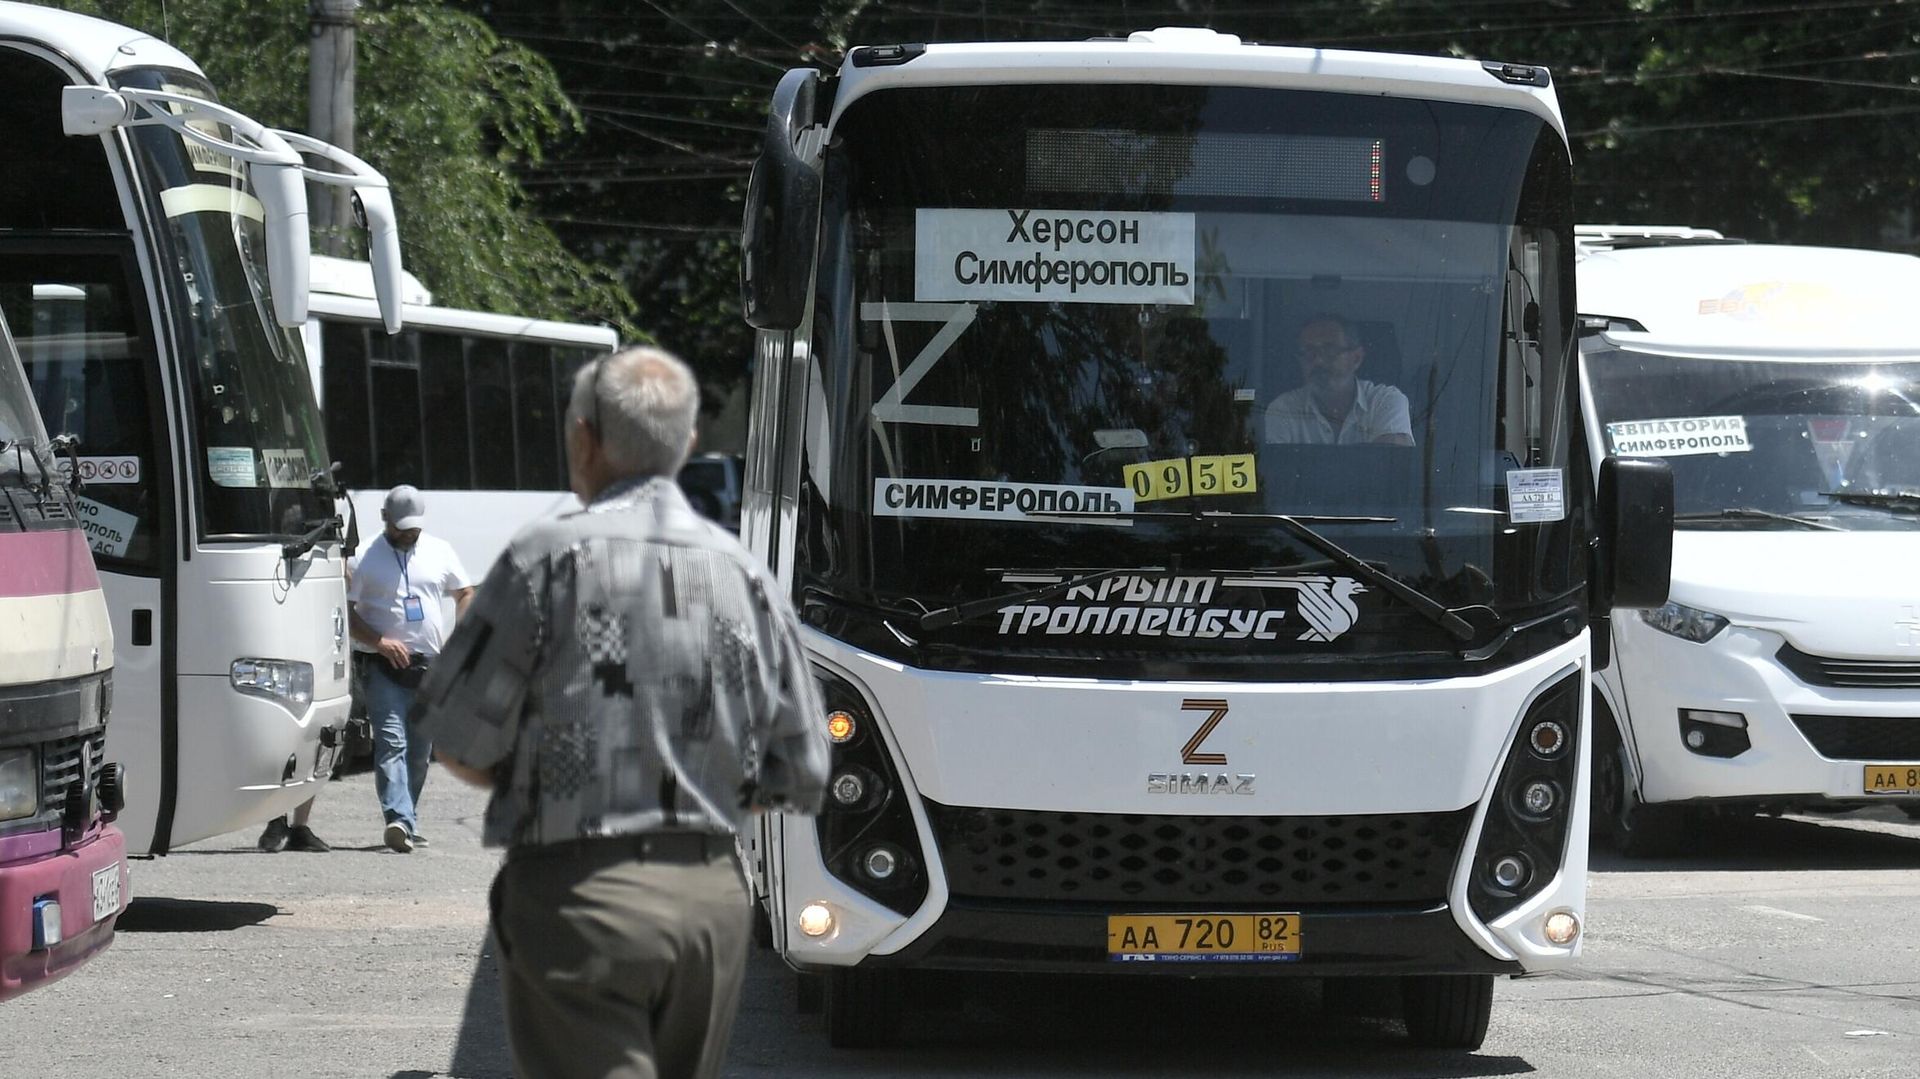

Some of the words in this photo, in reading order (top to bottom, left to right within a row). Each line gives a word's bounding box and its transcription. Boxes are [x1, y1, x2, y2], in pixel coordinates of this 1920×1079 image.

[1006, 209, 1139, 251] Херсон
[954, 251, 1189, 293] Симферополь
[860, 302, 979, 427] Z
[1614, 417, 1741, 436] ЕВПАТОРИЯ
[1619, 434, 1745, 453] СИМФЕРОПОЛЬ
[885, 482, 1122, 513] СИМФЕРОПОЛЬ
[1180, 698, 1229, 766] Z
[1147, 772, 1257, 796] SIMAZ
[1906, 768, 1920, 787] 8
[1175, 918, 1235, 949] 720
[1258, 917, 1288, 940] 82
[1262, 942, 1285, 951] RUS
